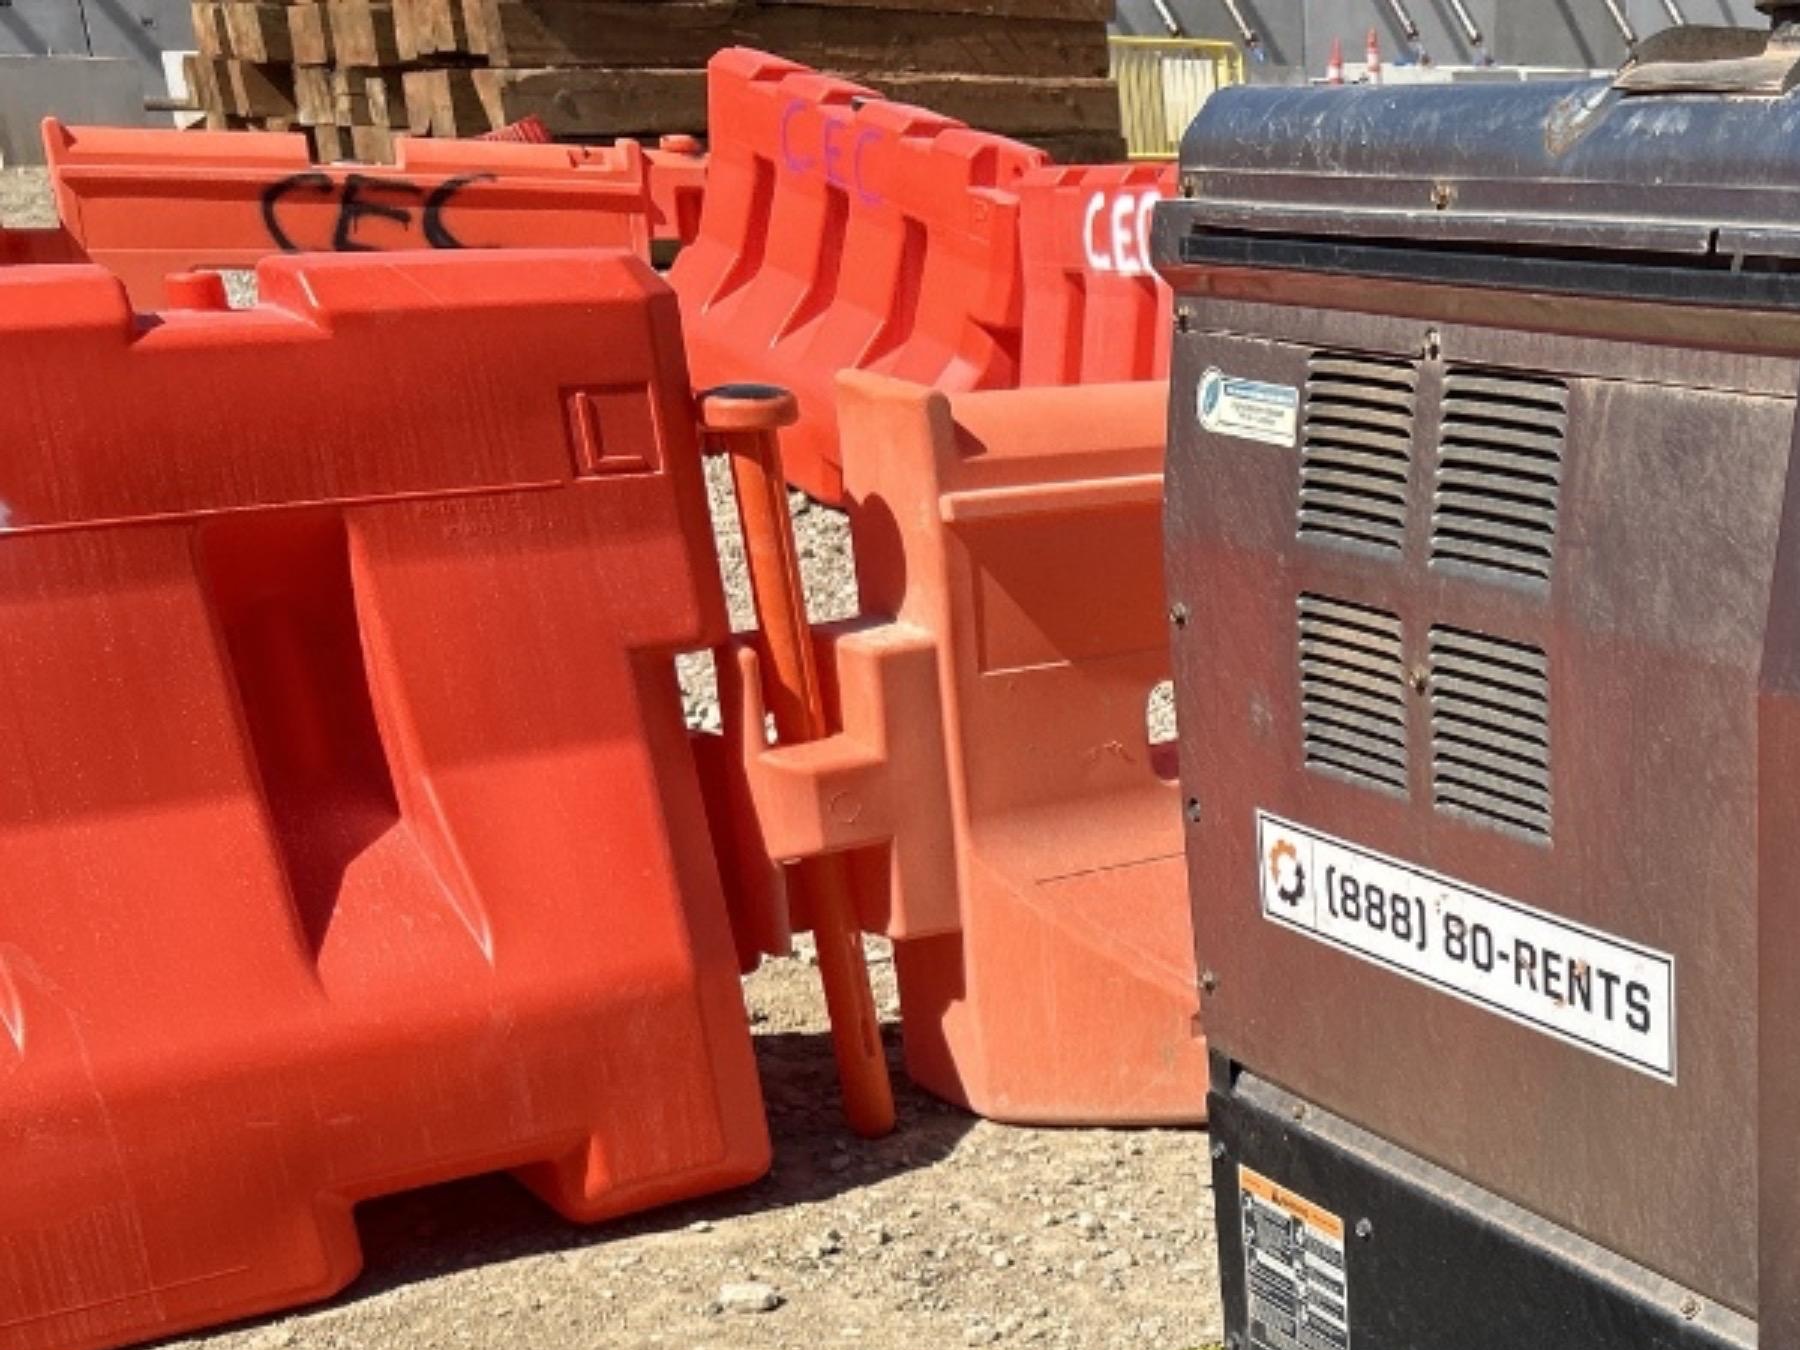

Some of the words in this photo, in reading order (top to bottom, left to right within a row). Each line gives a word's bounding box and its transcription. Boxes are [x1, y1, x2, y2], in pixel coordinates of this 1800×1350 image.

[782, 98, 884, 204] CEC
[261, 172, 502, 253] CEC
[1084, 190, 1161, 276] CEC
[1324, 865, 1427, 951] (888)
[1443, 914, 1651, 1035] 80-RENTS
